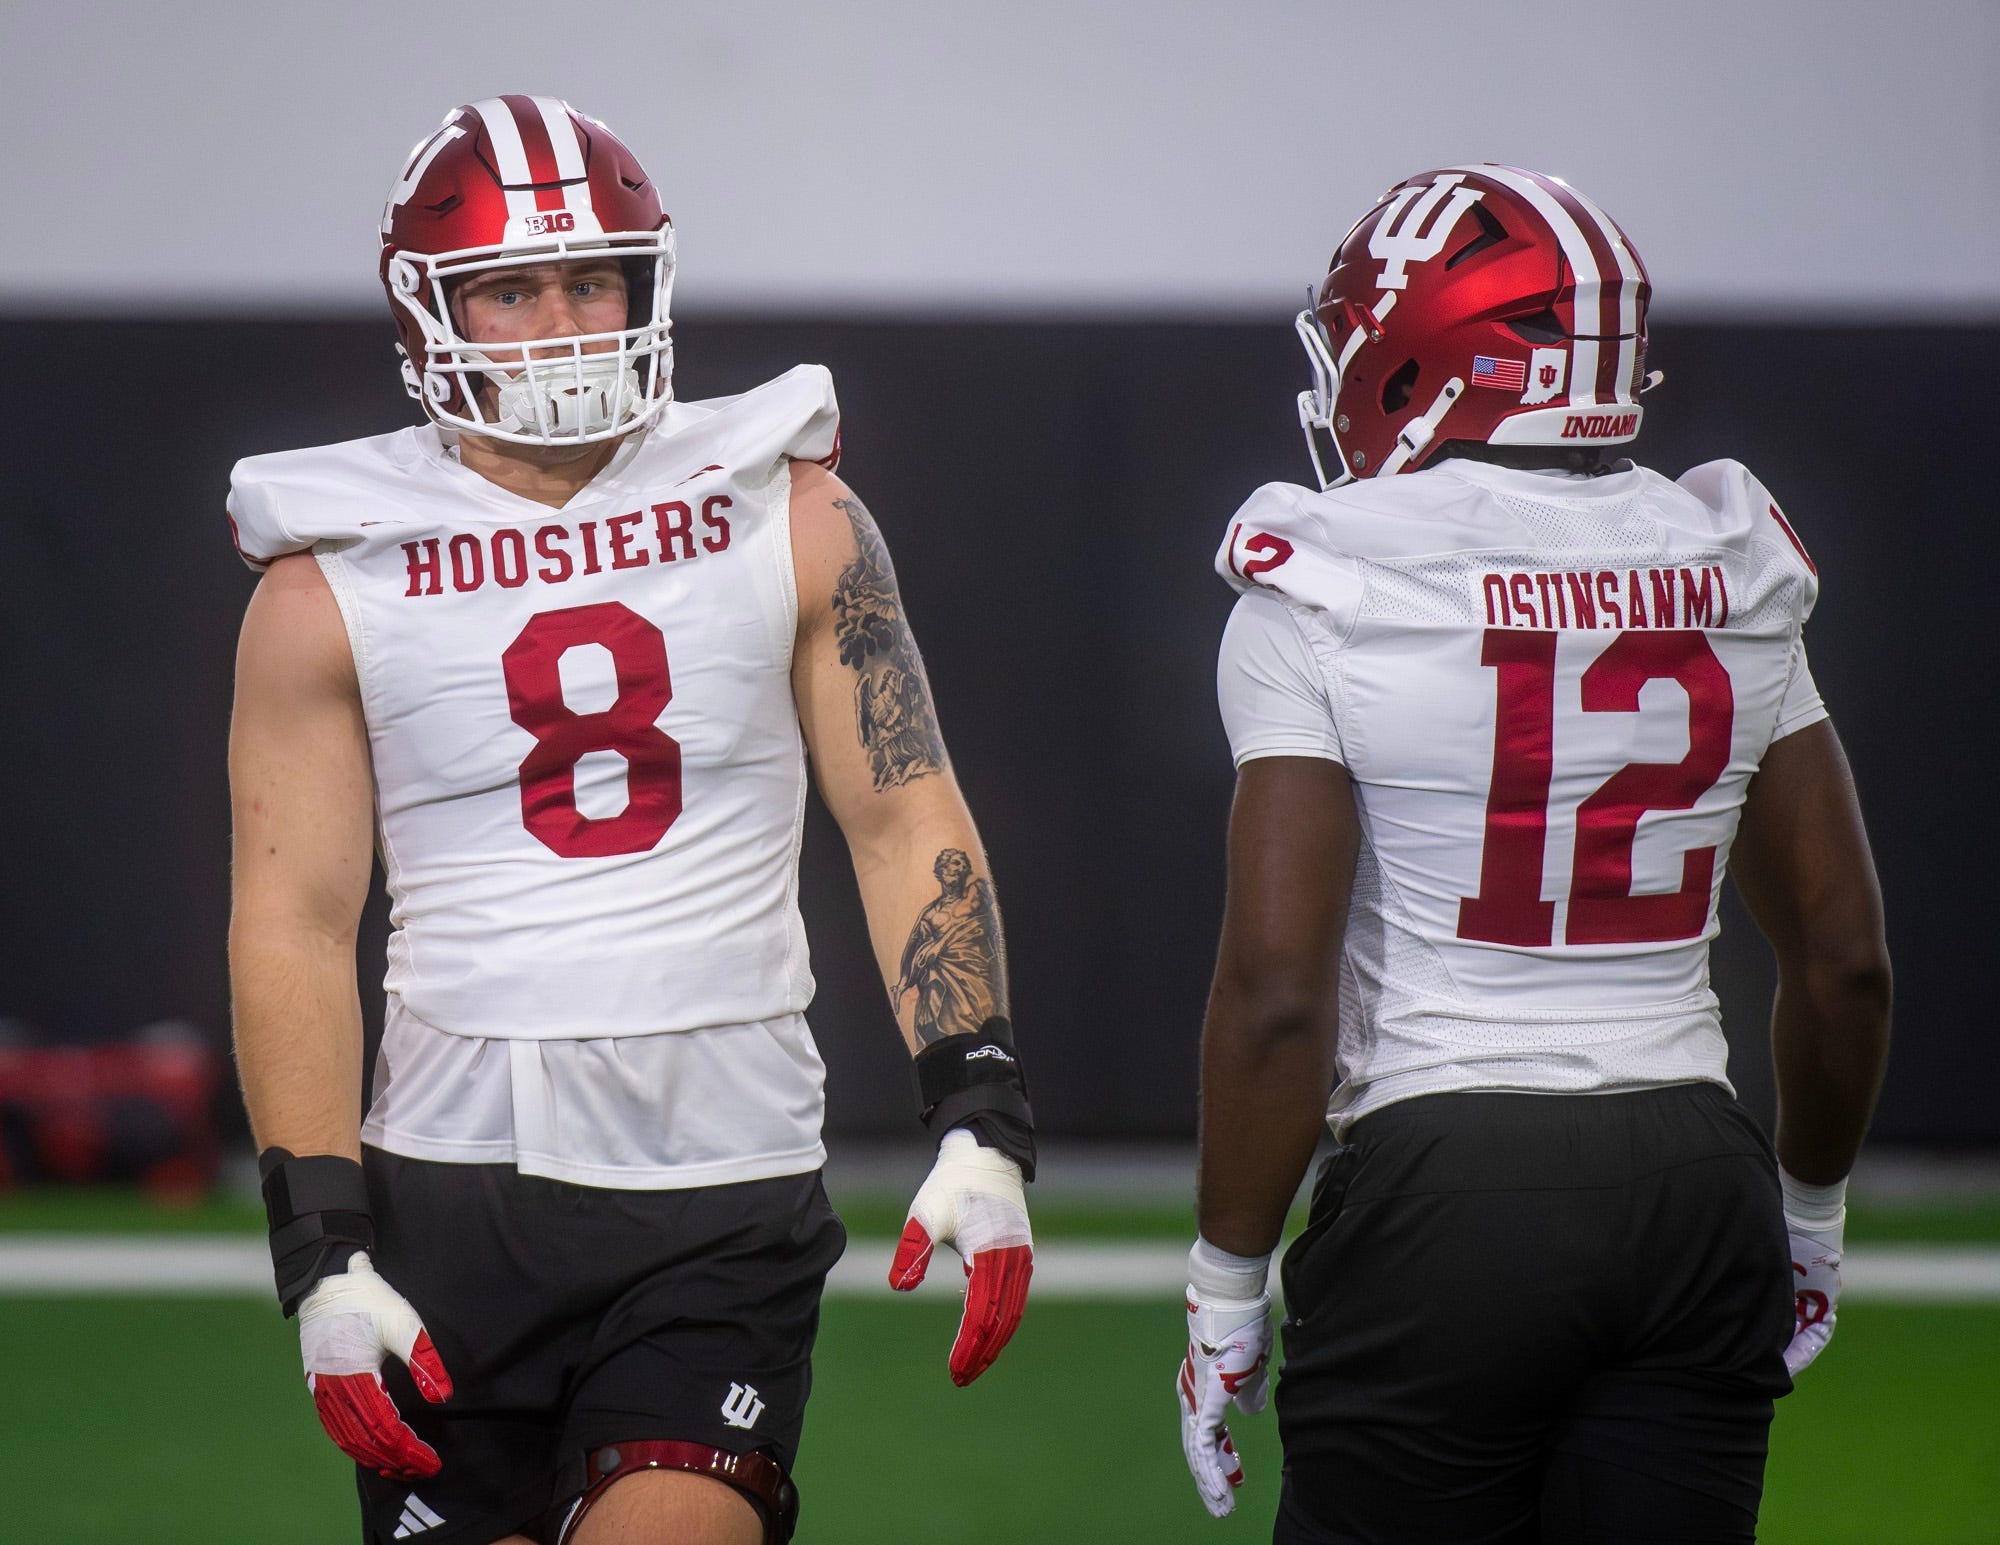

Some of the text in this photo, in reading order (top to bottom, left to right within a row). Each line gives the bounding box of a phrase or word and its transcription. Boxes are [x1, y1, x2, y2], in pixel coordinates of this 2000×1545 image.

[402, 494, 733, 597] HOOSIERS
[1482, 566, 1728, 629] OSUNSANMI
[501, 600, 683, 858] 8
[1456, 628, 1735, 946] 12
